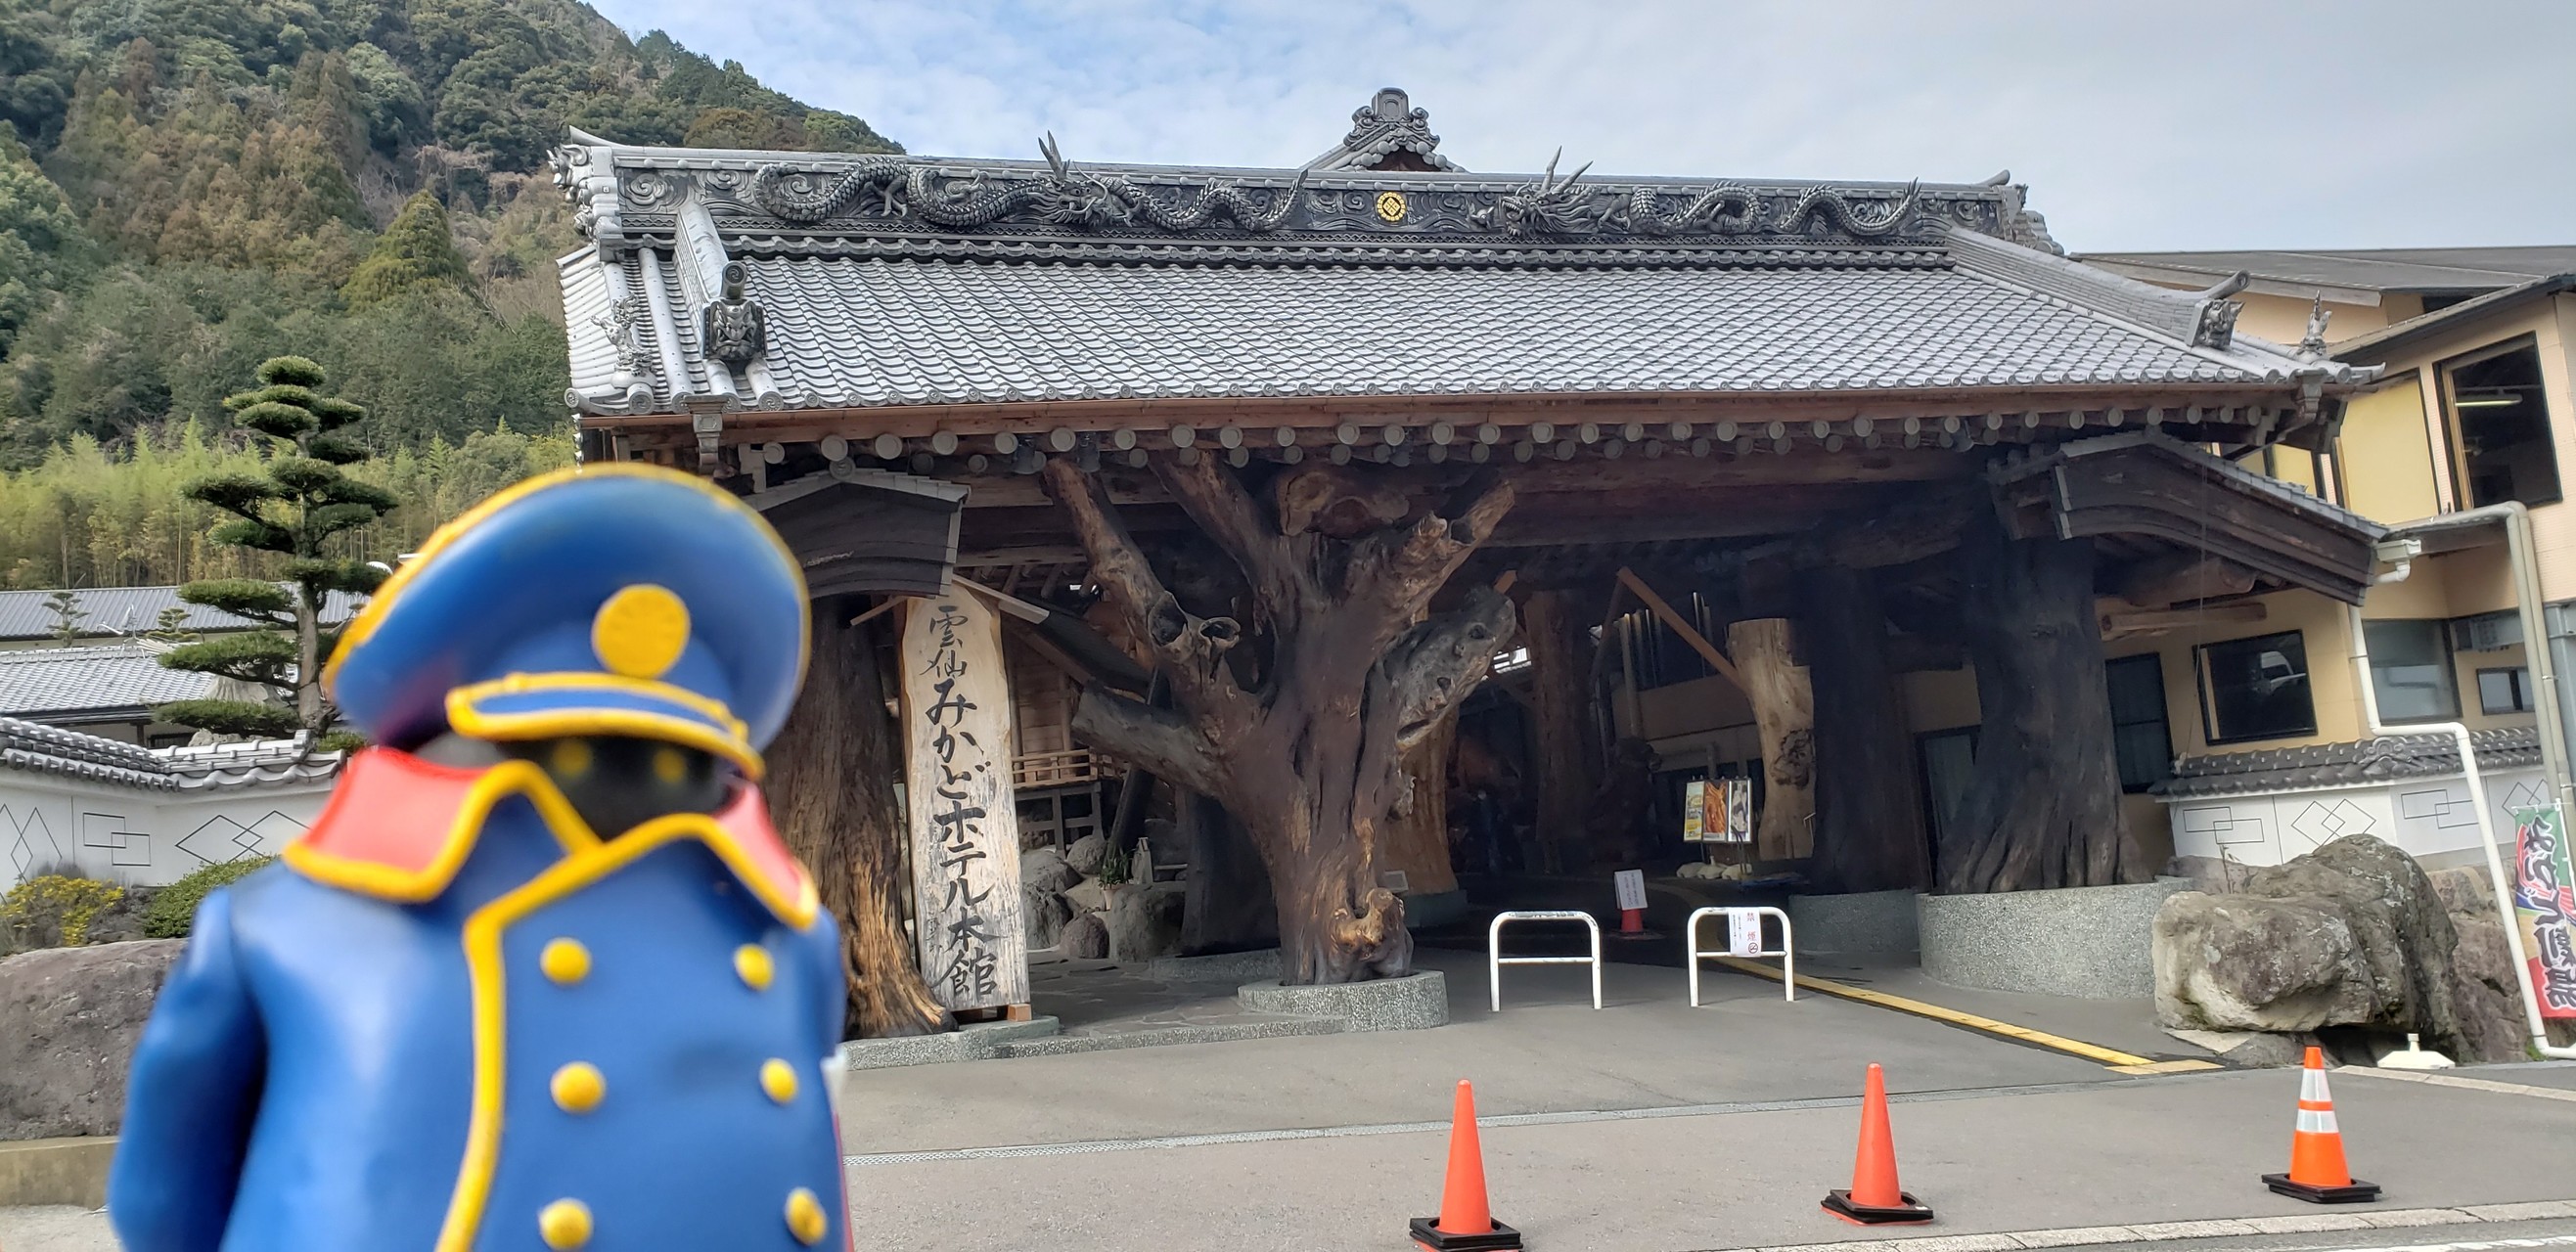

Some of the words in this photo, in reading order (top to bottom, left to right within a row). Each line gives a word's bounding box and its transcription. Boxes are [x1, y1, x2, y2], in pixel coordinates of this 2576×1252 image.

[920, 605, 1002, 997] 雲仙みかどホテル本館
[1746, 912, 1757, 941] 禁煙
